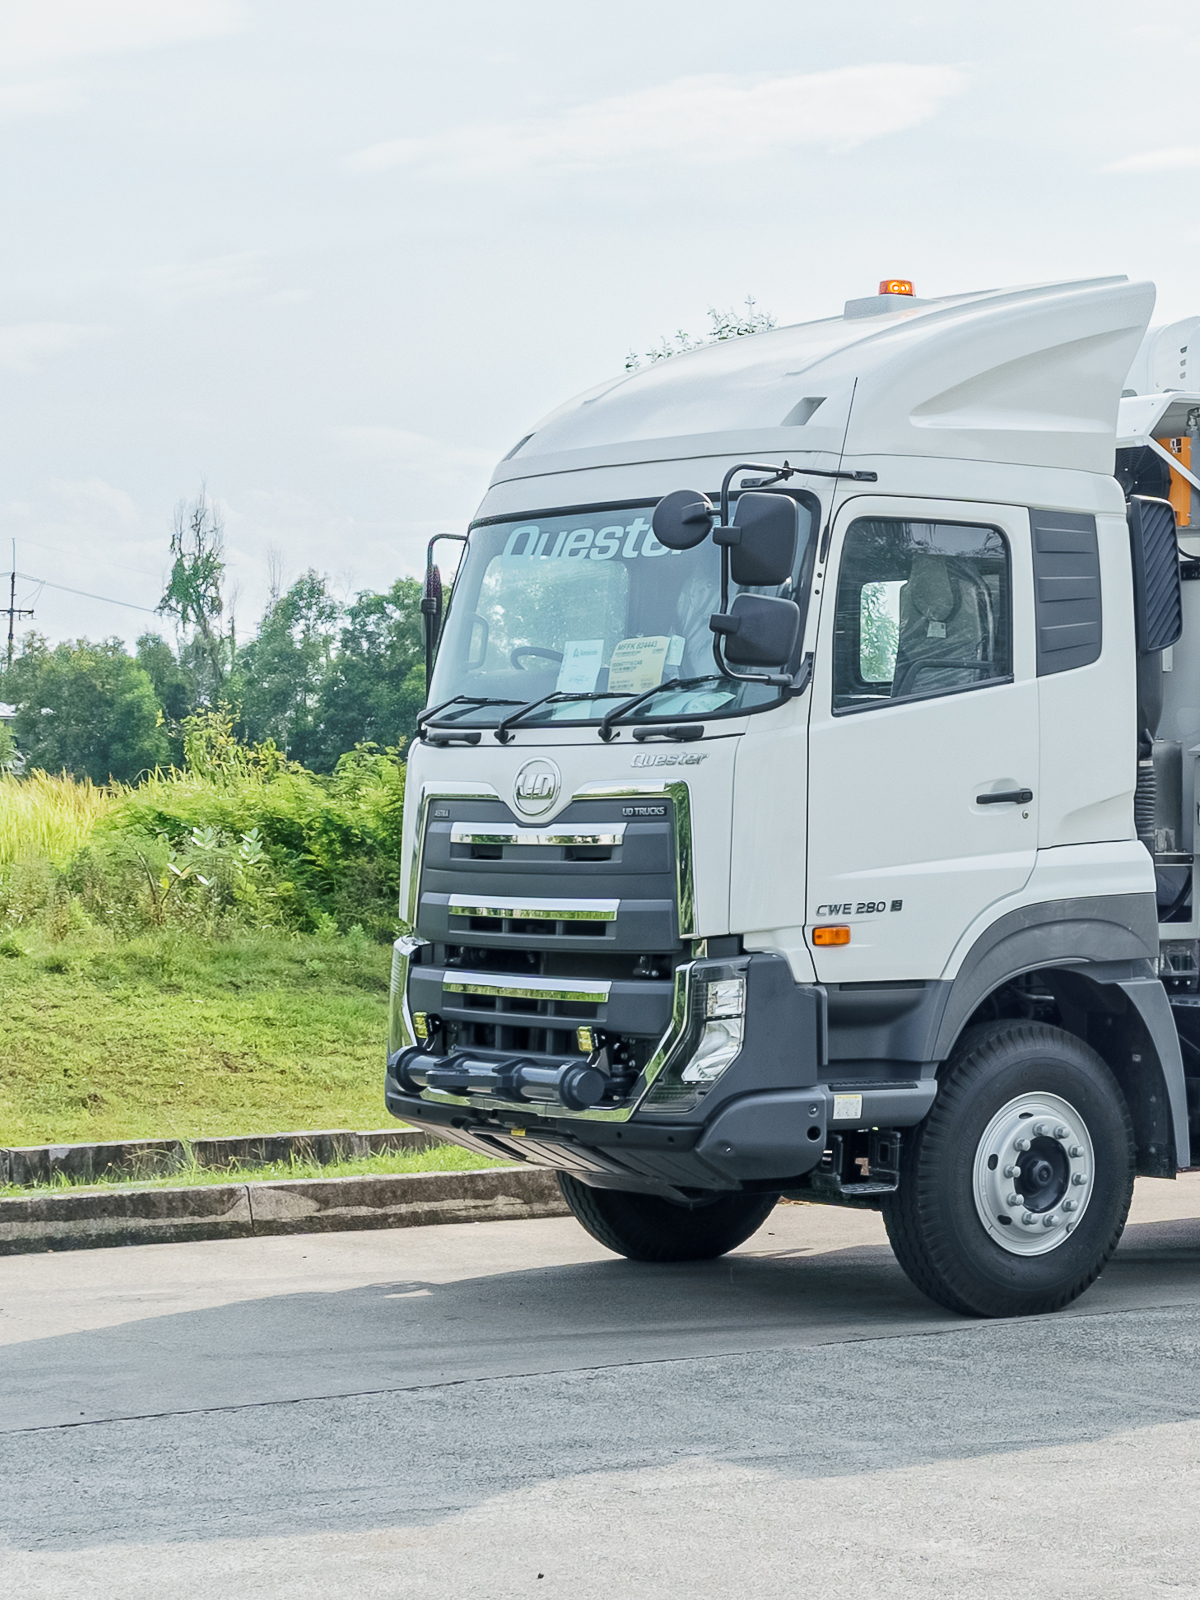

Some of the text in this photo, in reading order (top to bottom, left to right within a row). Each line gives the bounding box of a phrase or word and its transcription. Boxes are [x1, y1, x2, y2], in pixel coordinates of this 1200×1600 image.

[501, 517, 684, 561] Queste
[630, 751, 710, 769] Quester
[622, 806, 665, 816] UD TRUCKS
[816, 903, 852, 917] CWE
[855, 901, 886, 914] 280
